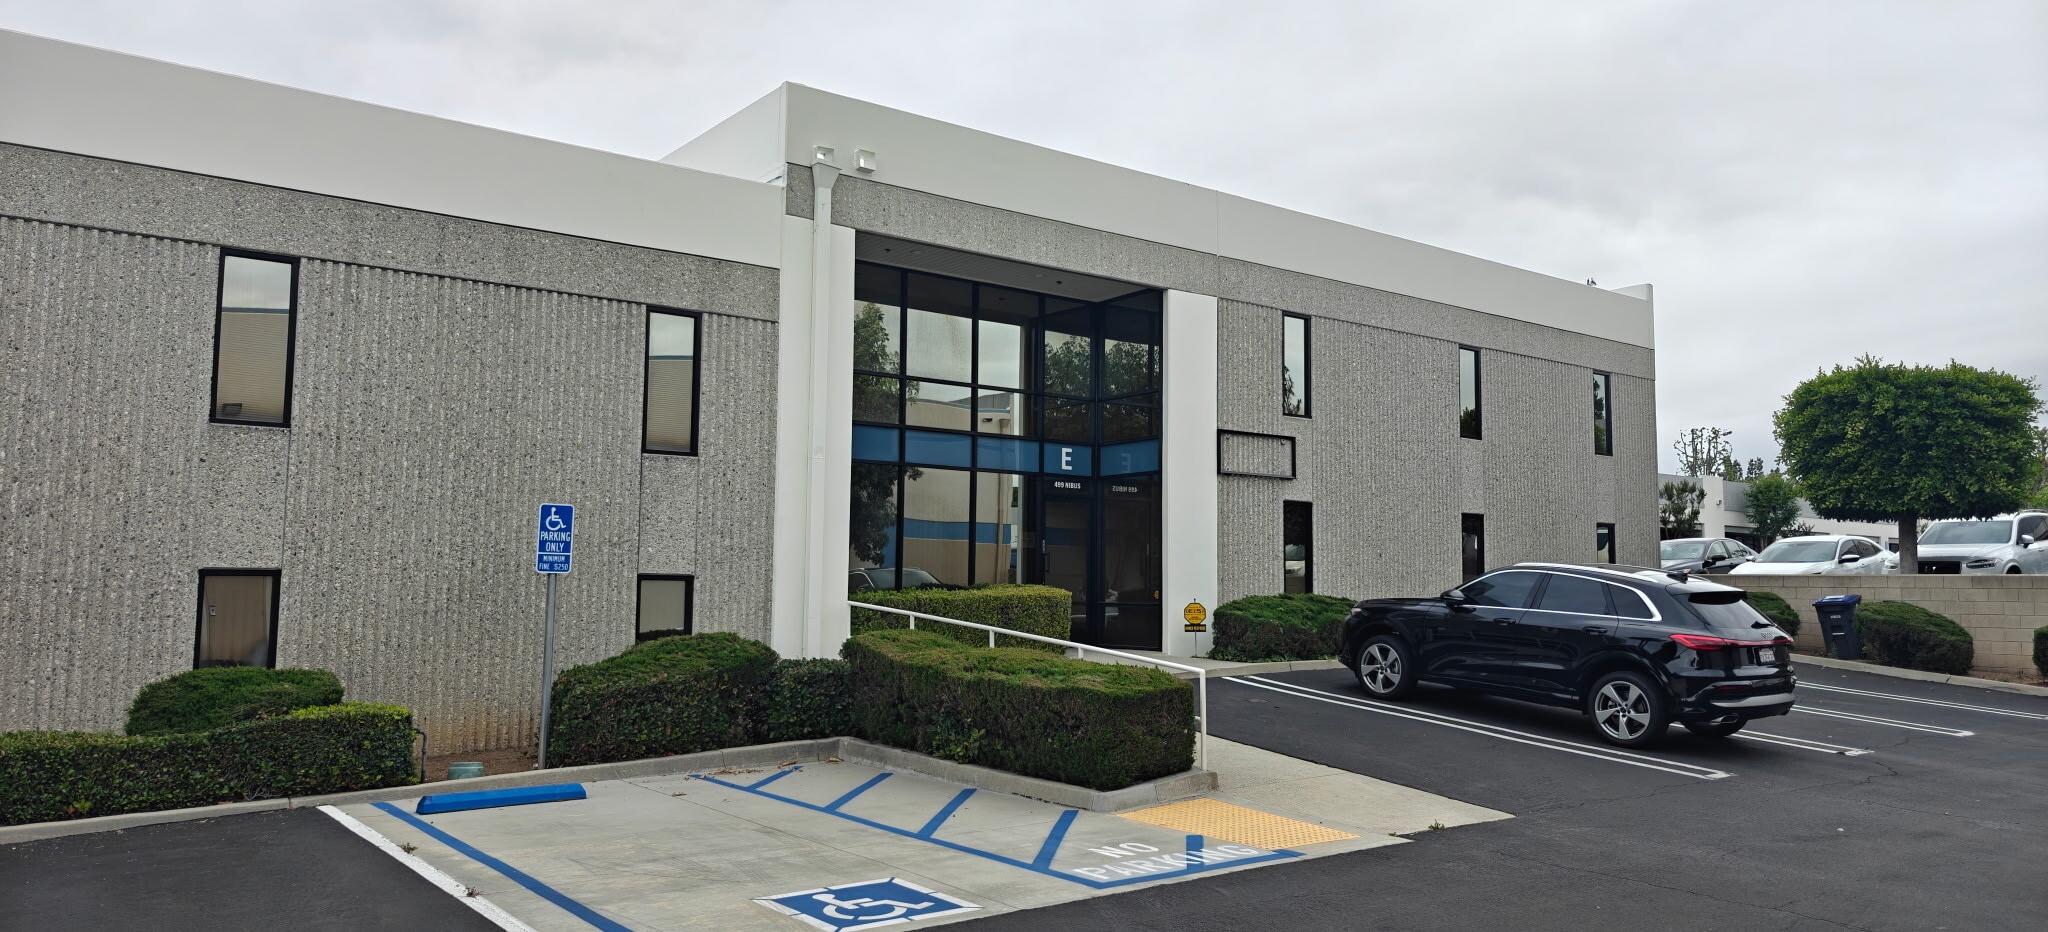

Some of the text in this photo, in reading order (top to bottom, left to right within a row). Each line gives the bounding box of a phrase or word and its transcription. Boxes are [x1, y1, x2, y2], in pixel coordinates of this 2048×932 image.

[1061, 447, 1072, 470] E
[1054, 481, 1065, 489] 499
[540, 531, 570, 542] PARKING
[545, 542, 565, 552] ONLY
[553, 563, 568, 571] $250
[1087, 842, 1160, 858] NO
[1071, 845, 1259, 880] PARKING
